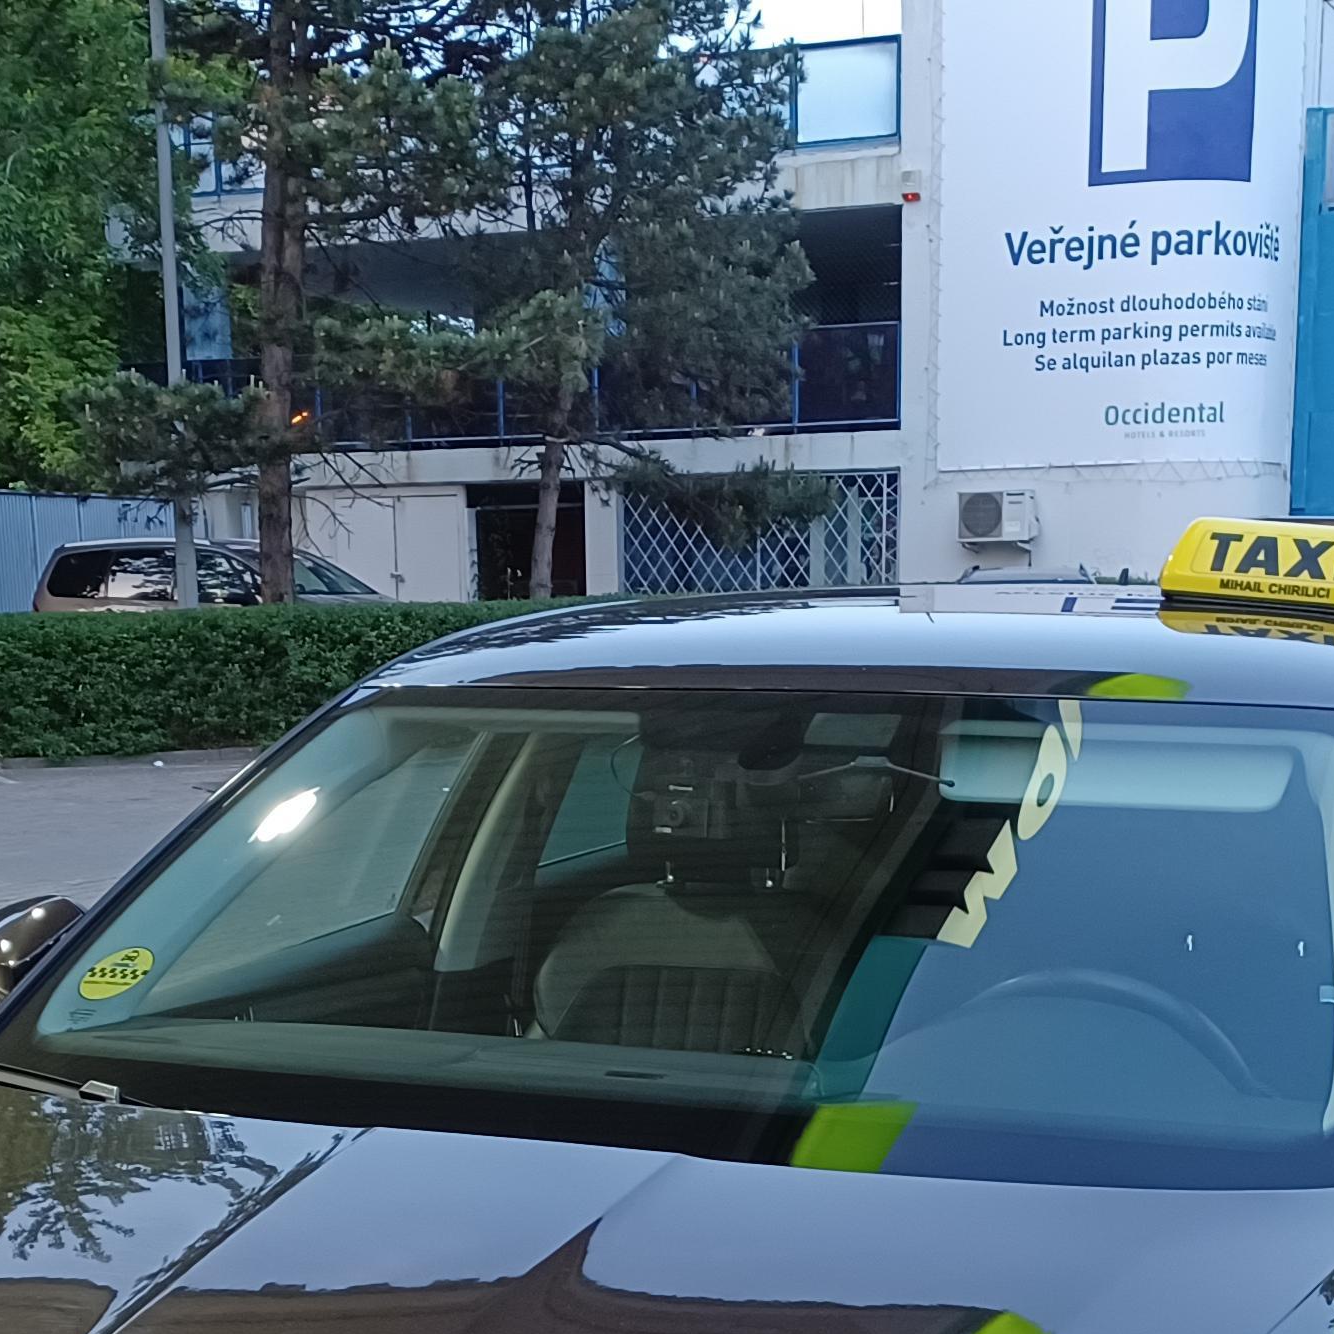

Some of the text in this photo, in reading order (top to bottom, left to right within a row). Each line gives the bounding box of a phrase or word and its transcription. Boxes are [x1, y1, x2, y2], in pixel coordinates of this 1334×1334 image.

[1005, 220, 1280, 270] Veřejné parkoviště
[1039, 294, 1116, 317] Možnost
[1120, 290, 1244, 313] dlouhodobého
[1003, 328, 1046, 348] Long
[1052, 326, 1096, 345] term
[1101, 324, 1173, 345] parking
[1178, 320, 1242, 341] permits
[1034, 354, 1057, 371] Se
[1062, 350, 1136, 372] alquilan
[1141, 349, 1202, 370] plazas
[1206, 351, 1233, 369] por
[1104, 401, 1225, 427] Occidental
[1219, 578, 1330, 599] MIHAIL CHIRILICI
